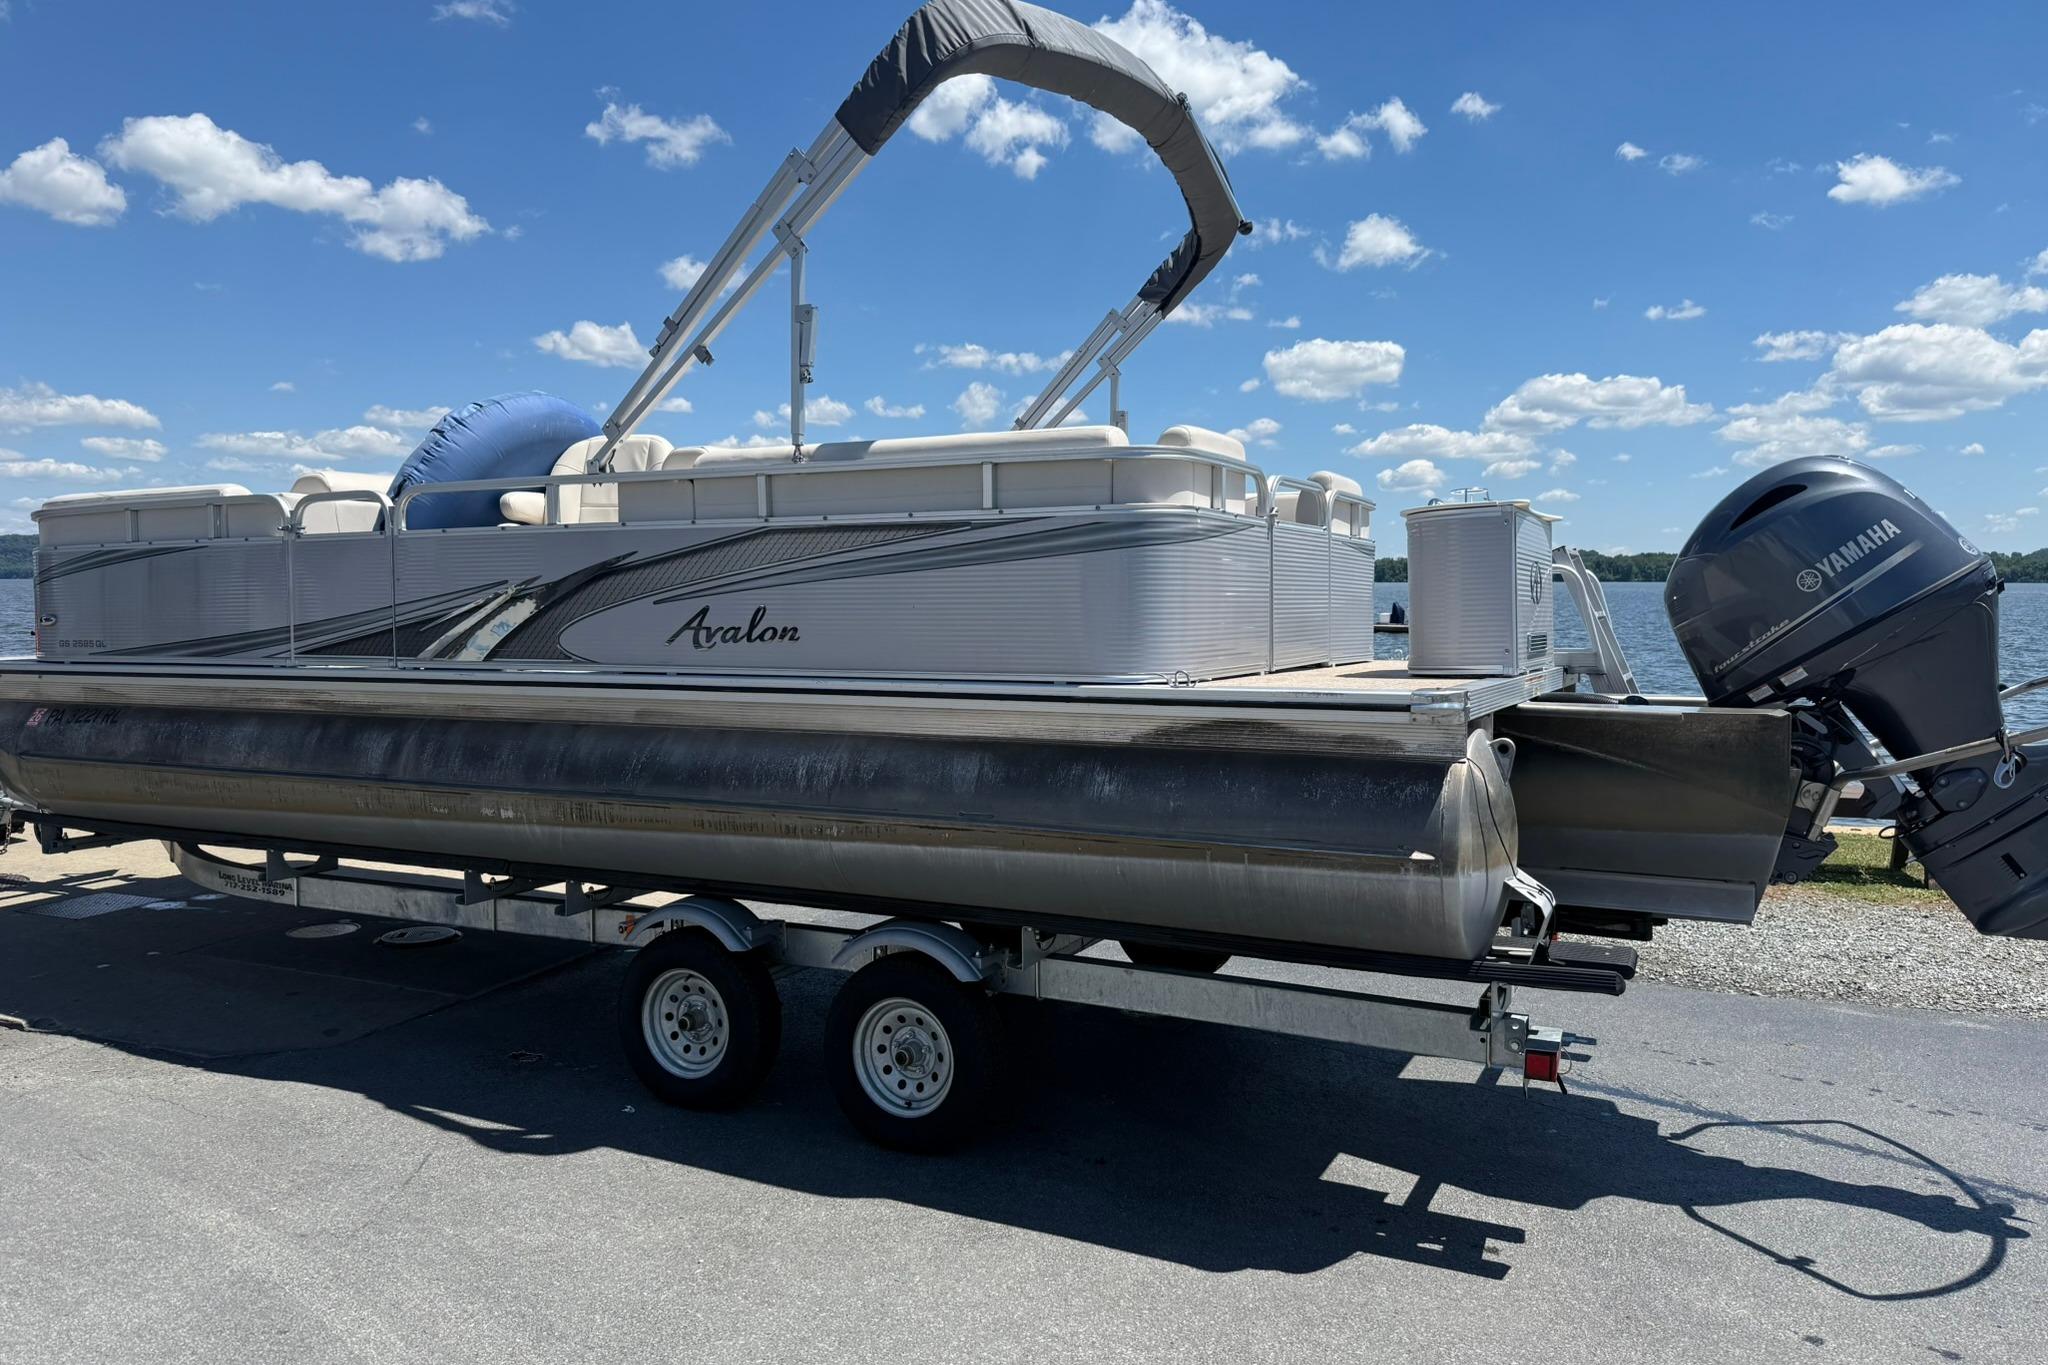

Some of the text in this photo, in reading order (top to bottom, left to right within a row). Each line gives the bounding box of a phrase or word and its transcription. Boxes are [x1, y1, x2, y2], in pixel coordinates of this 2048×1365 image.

[1815, 518, 1902, 578] YAMAHA
[664, 604, 801, 651] Avalon
[45, 708, 66, 726] PA
